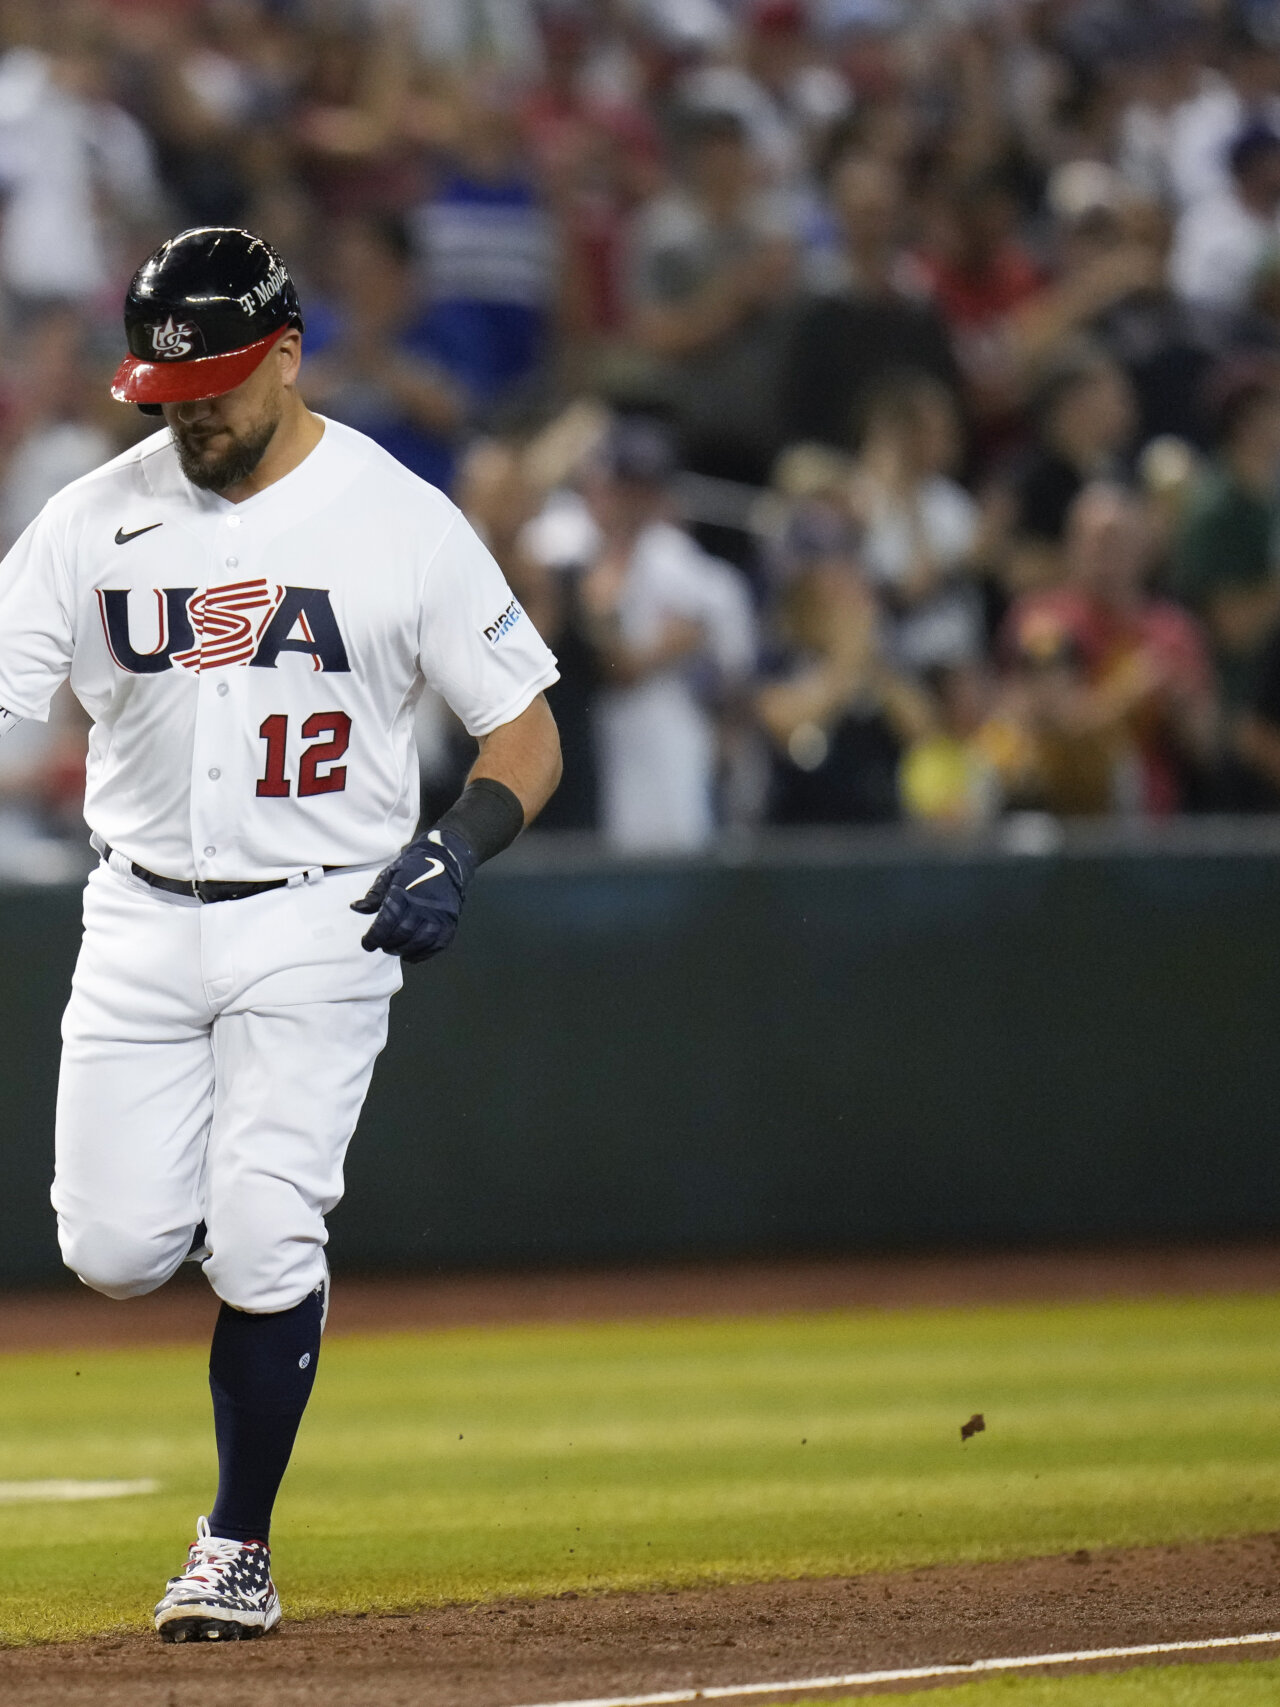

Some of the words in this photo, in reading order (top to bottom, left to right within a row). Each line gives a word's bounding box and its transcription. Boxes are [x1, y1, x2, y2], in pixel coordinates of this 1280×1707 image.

[252, 264, 288, 307] Mobile
[94, 578, 352, 673] USA
[256, 711, 352, 798] 12
